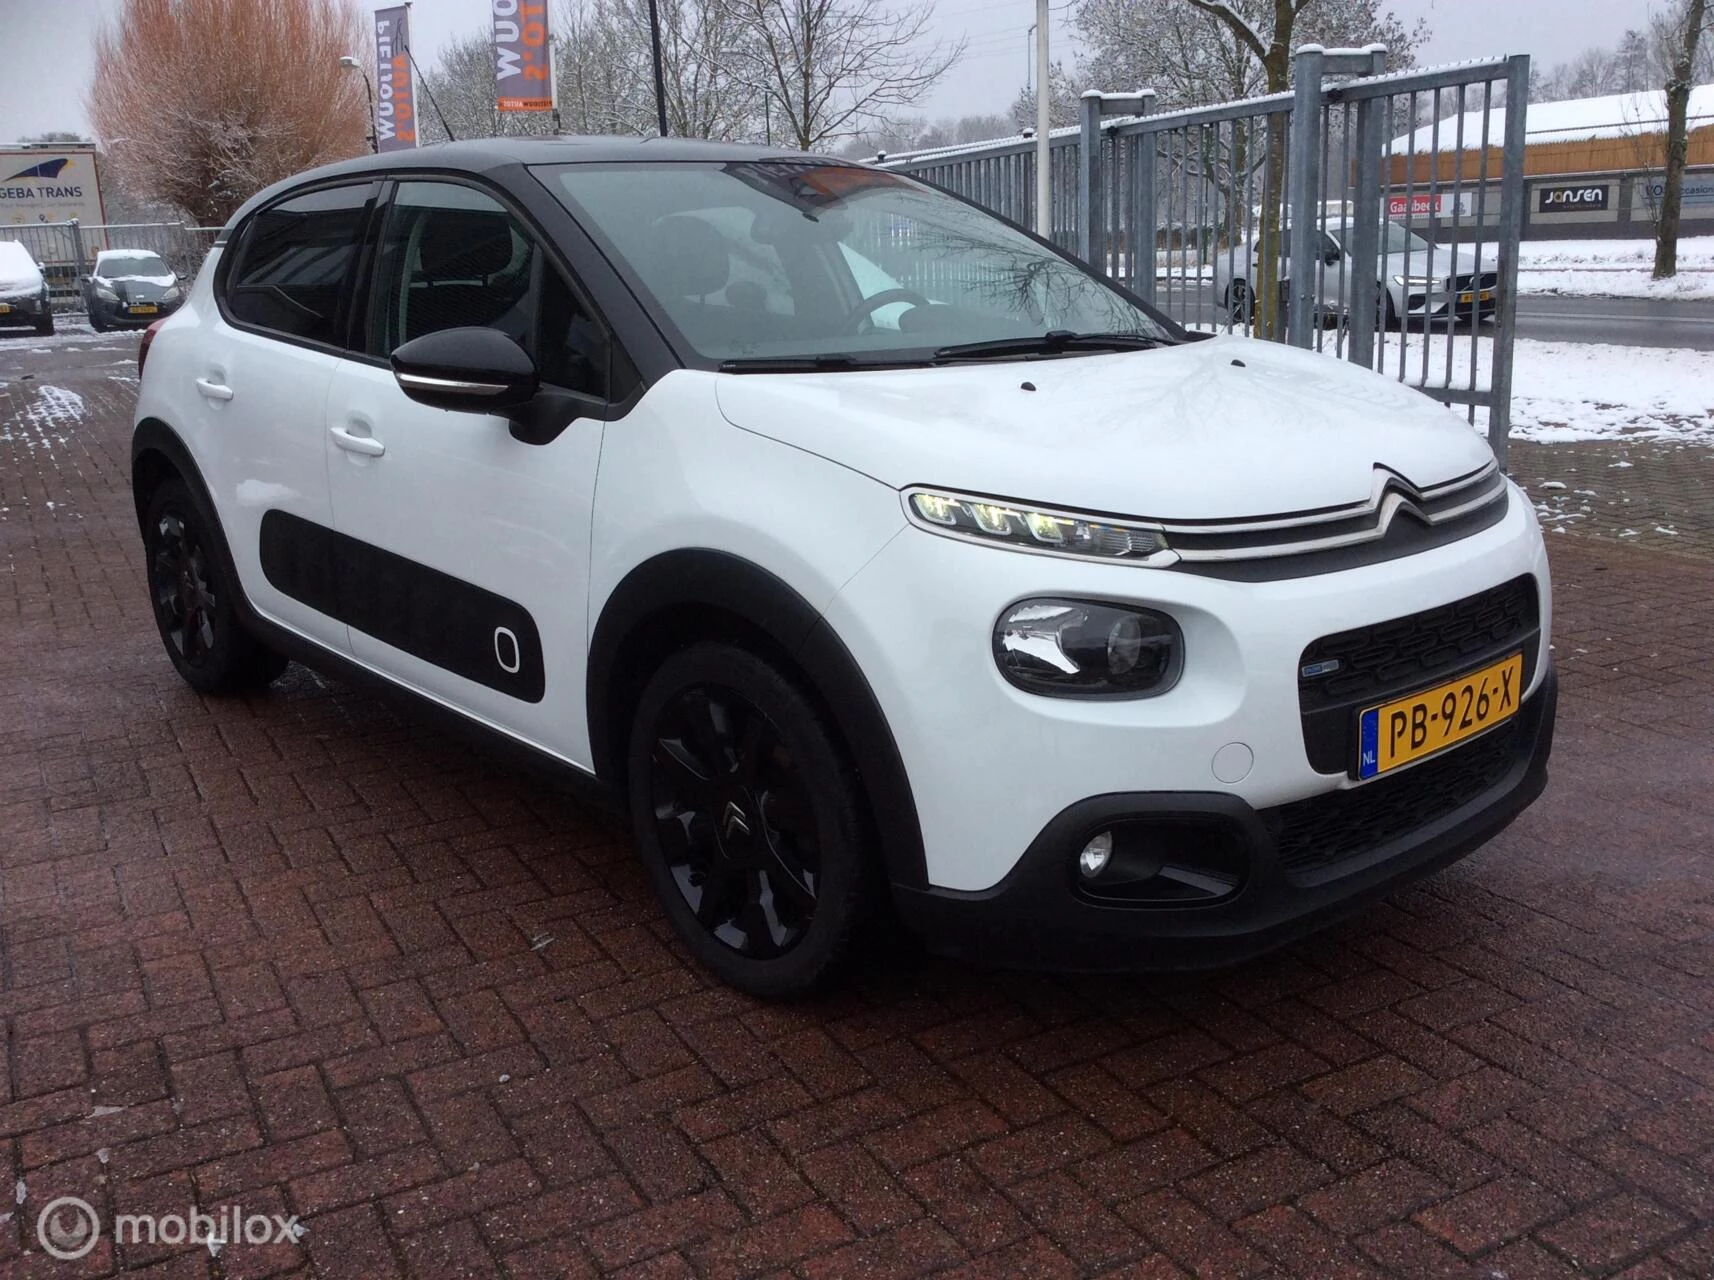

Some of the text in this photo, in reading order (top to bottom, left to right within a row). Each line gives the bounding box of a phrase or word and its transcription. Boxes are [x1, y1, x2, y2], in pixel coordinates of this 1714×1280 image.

[0, 186, 82, 199] GEBA TRANS
[1389, 200, 1439, 213] Gaabeek
[1389, 665, 1515, 759] PB-926-X
[1362, 755, 1376, 767] NL
